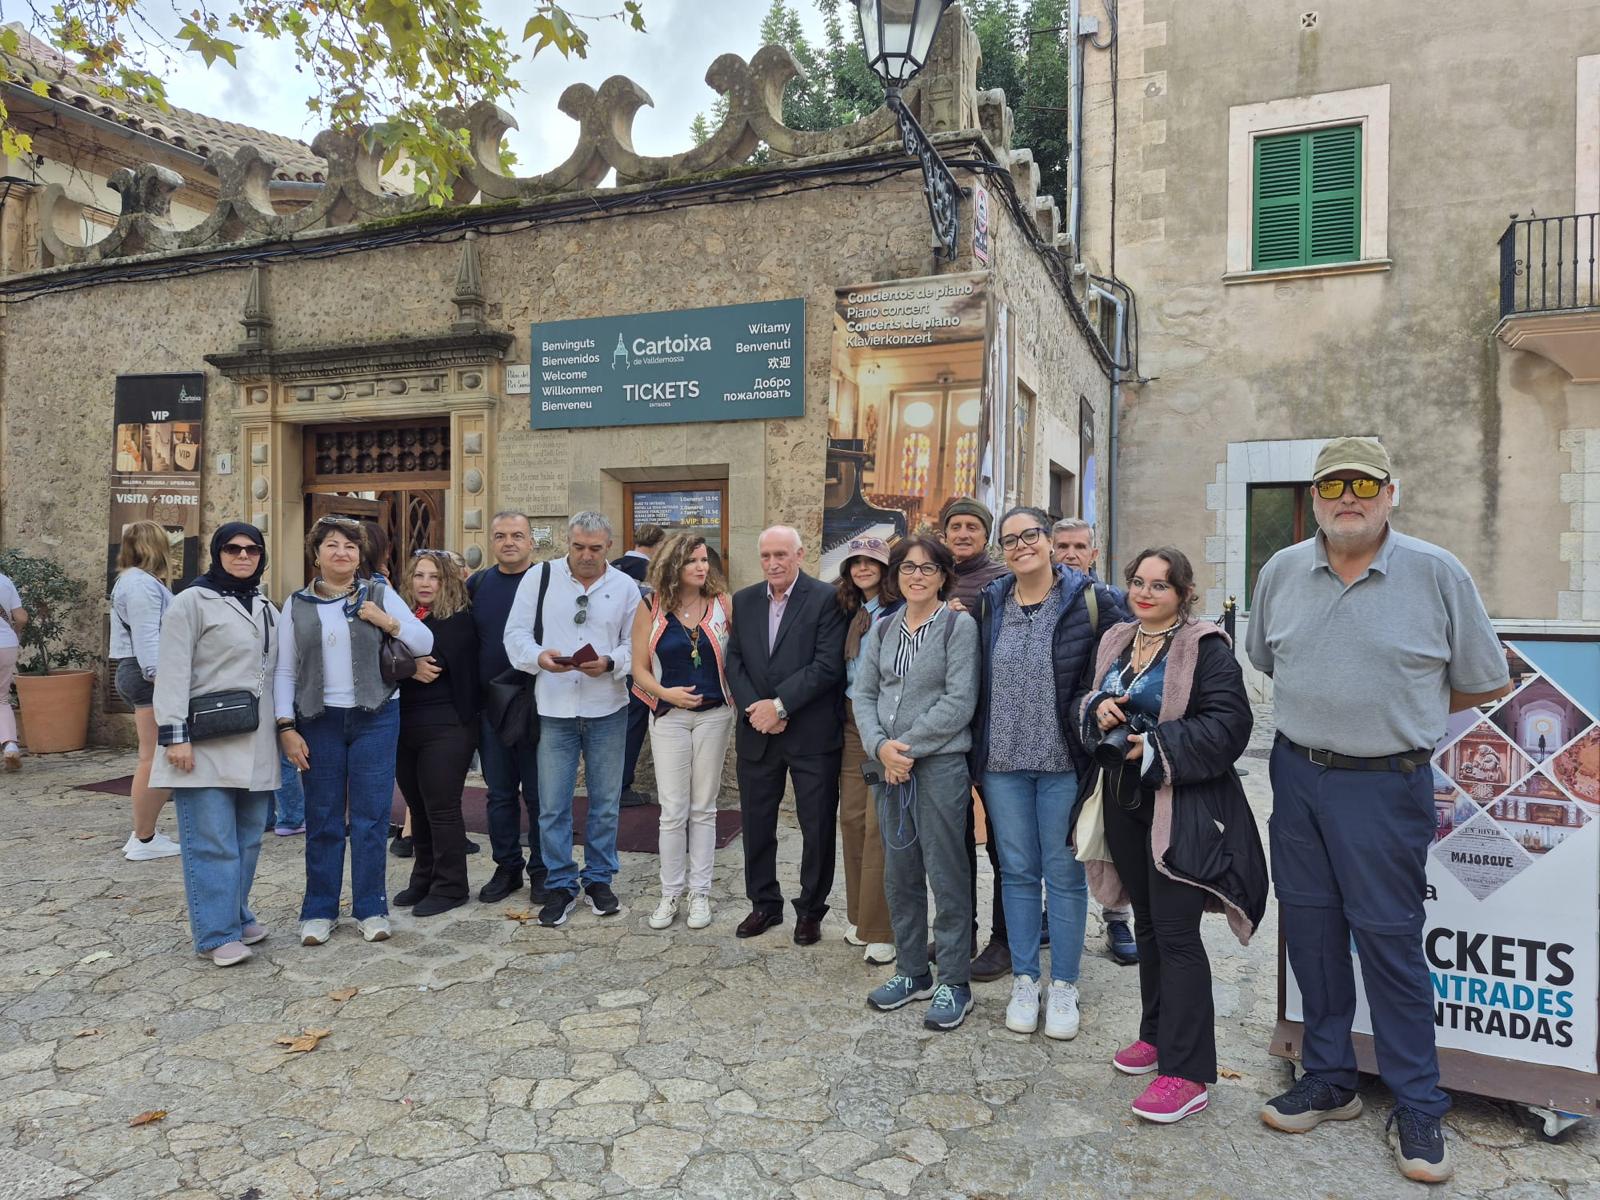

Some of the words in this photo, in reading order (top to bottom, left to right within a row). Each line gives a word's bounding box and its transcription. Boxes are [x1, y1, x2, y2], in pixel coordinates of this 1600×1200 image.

[847, 288, 914, 304] Conciertos
[917, 287, 934, 299] de
[935, 284, 973, 300] piano
[847, 306, 879, 319] Piano
[881, 304, 930, 317] concert
[748, 322, 791, 335] Witamy
[846, 318, 901, 332] Concerts
[903, 316, 920, 329] de
[922, 315, 960, 331] piano
[542, 338, 595, 352] Benvinguts
[632, 333, 712, 356] Cartoixa
[735, 338, 791, 353] Benvenuti
[846, 332, 933, 348] Klavierkonzert
[542, 353, 600, 366] Bienvenidos
[767, 355, 791, 369] 欢迎
[542, 370, 587, 381] Welcome
[542, 385, 603, 396] Willkommen
[622, 380, 700, 401] TICKETS
[753, 377, 791, 390] Добро
[723, 389, 791, 401] пожаловать
[541, 401, 592, 412] Bienveneu
[151, 410, 170, 421] VIP
[179, 448, 191, 459] VIP
[116, 493, 149, 504] VISITA
[160, 494, 198, 505] TORRE
[1451, 851, 1514, 868] MAJORQUE
[1425, 927, 1575, 986] CKETS
[1430, 972, 1574, 1018] NTRADES
[1434, 1001, 1573, 1048] NTRADAS
